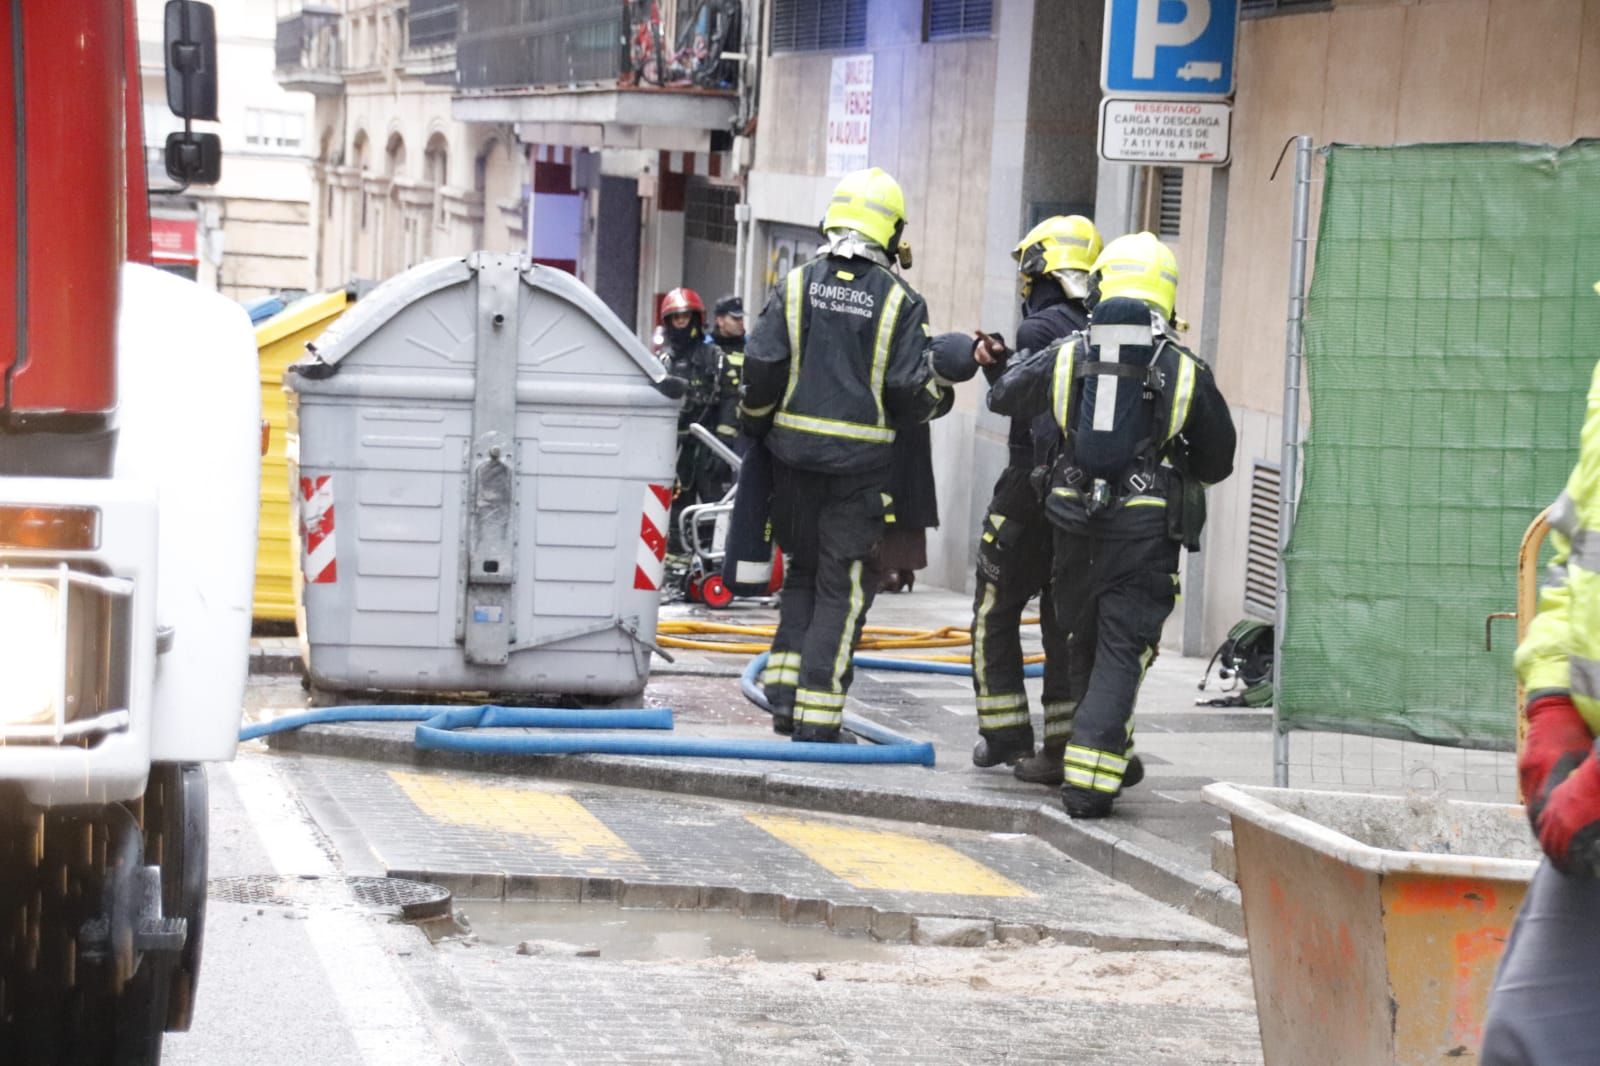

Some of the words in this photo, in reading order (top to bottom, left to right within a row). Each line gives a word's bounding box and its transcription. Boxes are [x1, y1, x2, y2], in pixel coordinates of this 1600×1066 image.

[1132, 0, 1211, 80] P
[845, 91, 871, 115] VENDE
[1135, 103, 1201, 114] RESERVADO
[1114, 114, 1150, 124] CARGA
[1154, 115, 1161, 124] Y
[1163, 115, 1220, 126] DESCARGA
[1123, 127, 1192, 137] LABORABLES
[1195, 129, 1209, 138] DE
[1123, 139, 1129, 147] 7
[1131, 139, 1138, 147] A
[1142, 139, 1151, 148] 11
[1155, 140, 1162, 148] Y
[1178, 140, 1185, 149] A
[809, 282, 874, 307] BOMBEROS
